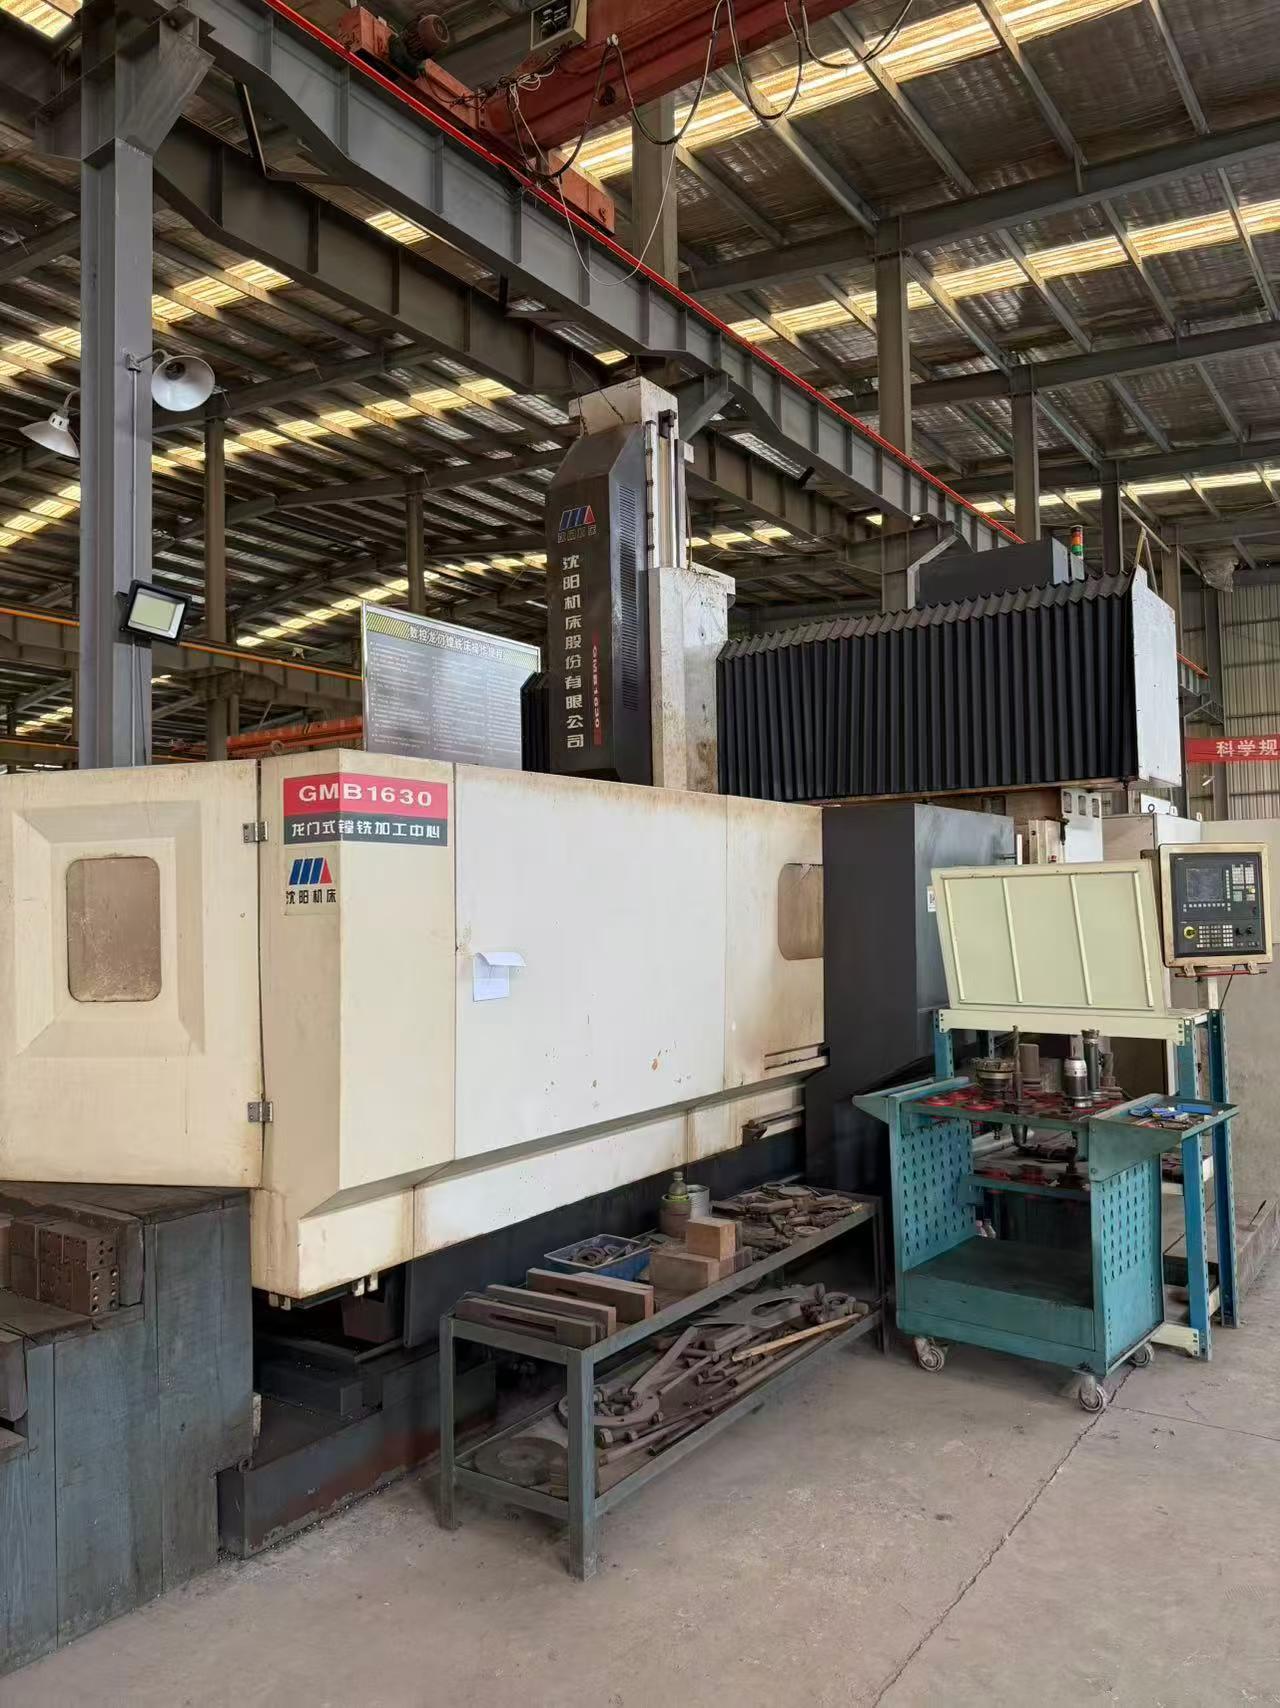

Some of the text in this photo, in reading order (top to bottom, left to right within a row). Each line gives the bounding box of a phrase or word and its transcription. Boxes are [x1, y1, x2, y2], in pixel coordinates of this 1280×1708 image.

[562, 554, 585, 749] 沈阳机床股份有限公司
[1216, 739, 1279, 757] 科学规
[298, 782, 432, 807] GMB1630
[292, 819, 440, 839] 龙门式镗铣加工中心
[285, 888, 337, 905] 沈阳机床
